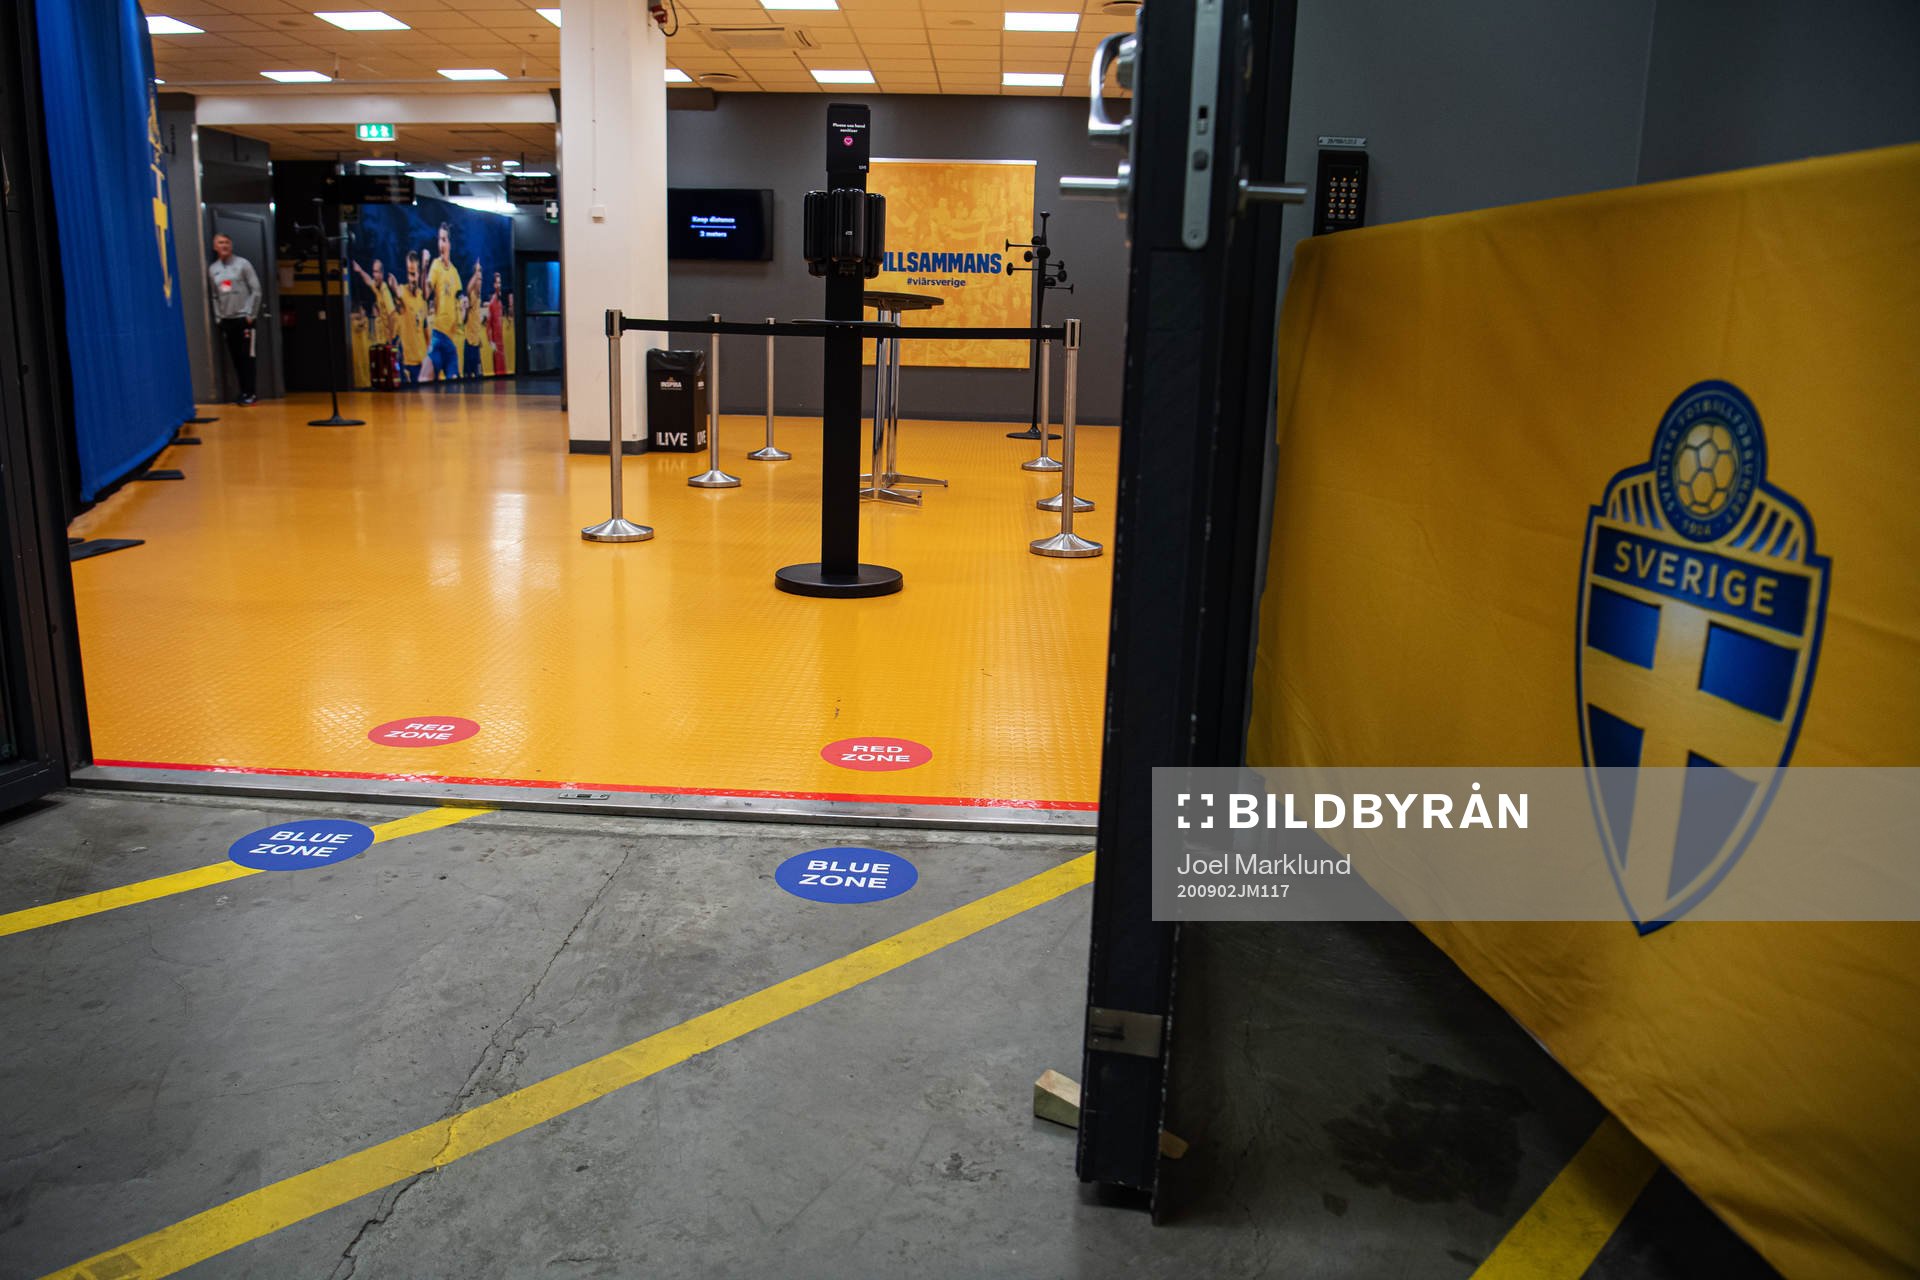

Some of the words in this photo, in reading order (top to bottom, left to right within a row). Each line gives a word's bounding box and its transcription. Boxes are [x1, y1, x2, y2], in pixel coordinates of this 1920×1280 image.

[692, 216, 708, 224] Keep
[883, 251, 1001, 274] ILLSAMMANS
[906, 277, 966, 287] #viärsverige
[1613, 540, 1779, 616] SVERIGE
[404, 722, 456, 732] RED
[384, 730, 453, 741] ZONE
[852, 745, 904, 754] RED
[840, 753, 911, 763] ZONE
[269, 830, 353, 845] BLUE
[248, 843, 338, 858] ZONE
[807, 859, 891, 875] BLUE
[798, 873, 888, 889] ZONE
